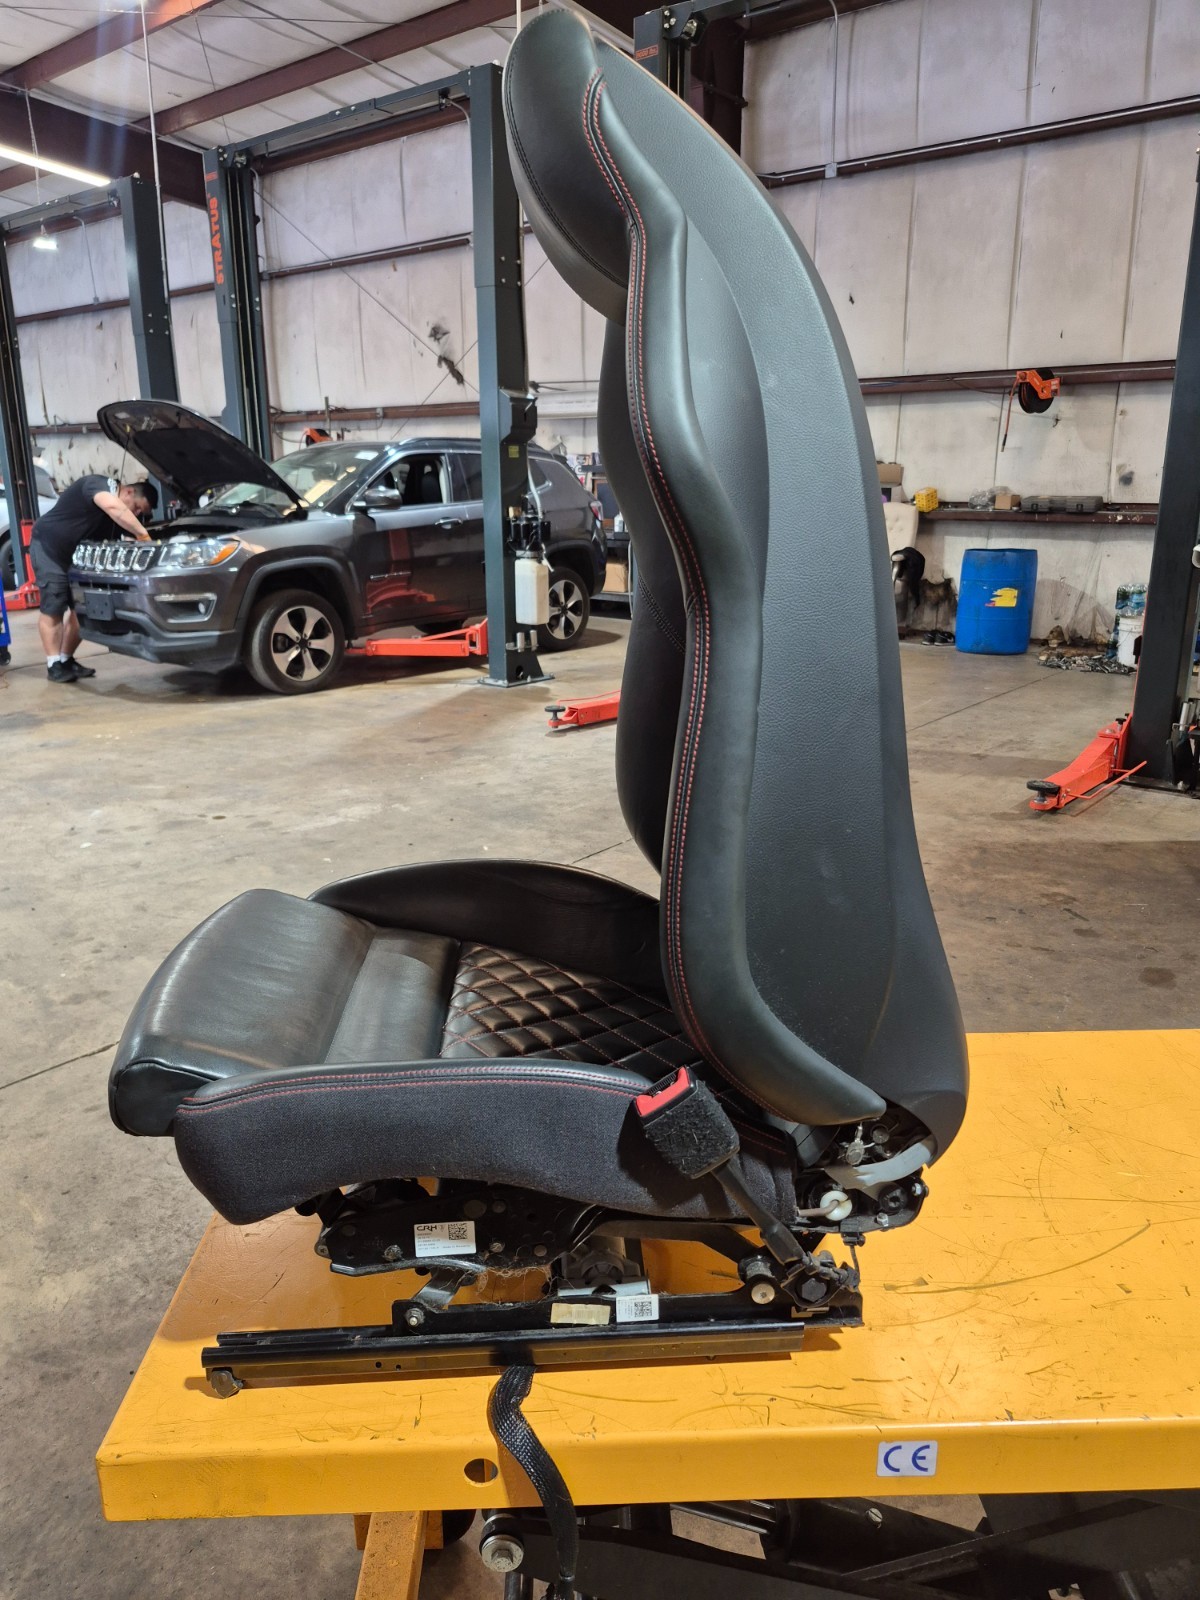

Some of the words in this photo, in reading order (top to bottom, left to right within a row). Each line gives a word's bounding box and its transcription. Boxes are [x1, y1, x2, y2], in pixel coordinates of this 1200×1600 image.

[209, 197, 225, 285] STRATUS
[416, 1224, 438, 1232] CRH
[883, 1444, 930, 1473] CE
